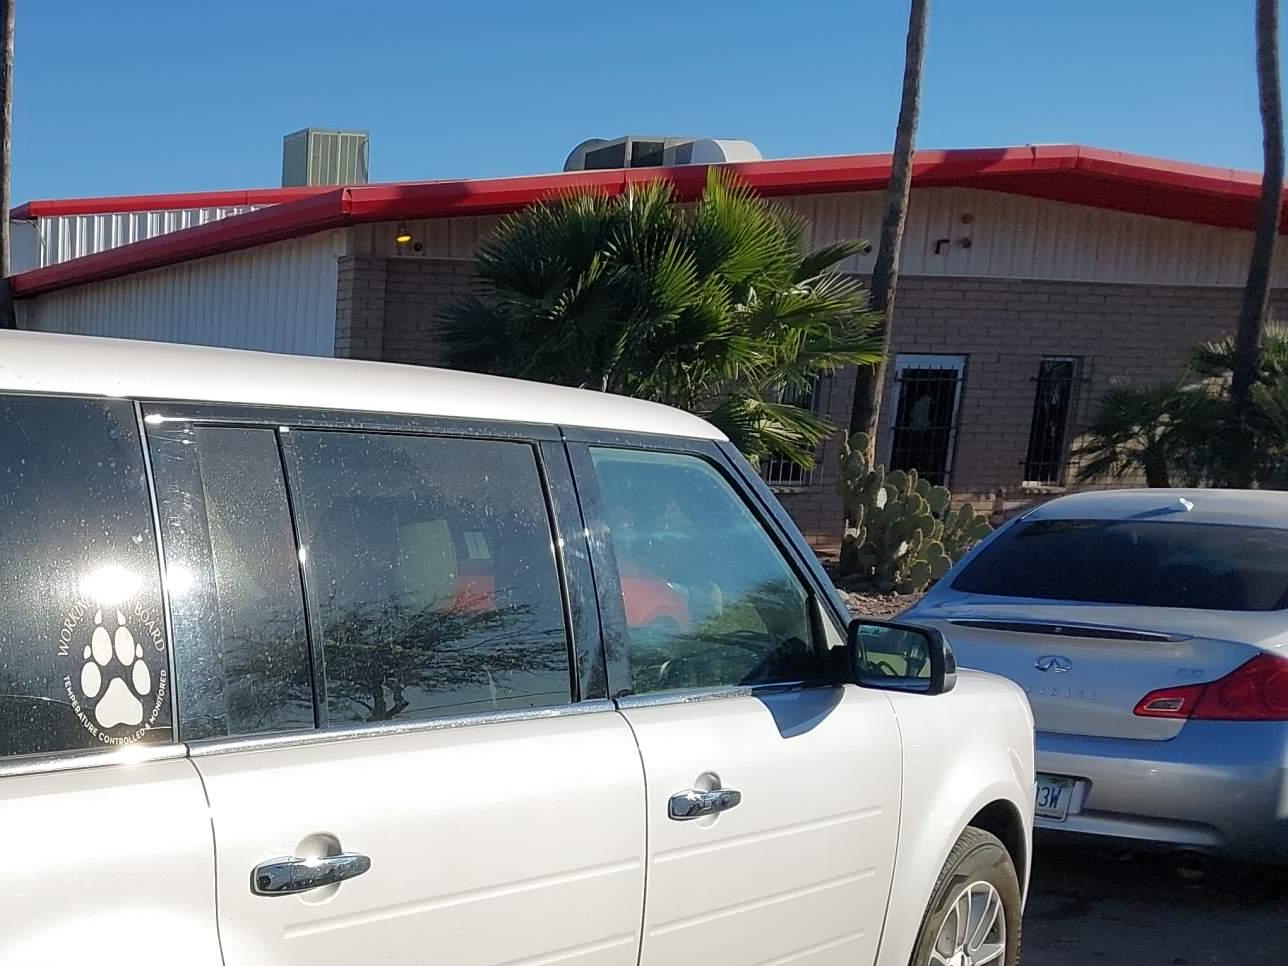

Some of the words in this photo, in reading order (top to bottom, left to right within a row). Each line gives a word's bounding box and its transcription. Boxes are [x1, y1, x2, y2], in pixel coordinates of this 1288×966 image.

[134, 602, 165, 651] BOARD
[63, 674, 99, 736] TEMPERATURE
[98, 728, 145, 745] CONTROLLED
[149, 669, 167, 724] MONITORED
[1036, 785, 1063, 809] 3W
